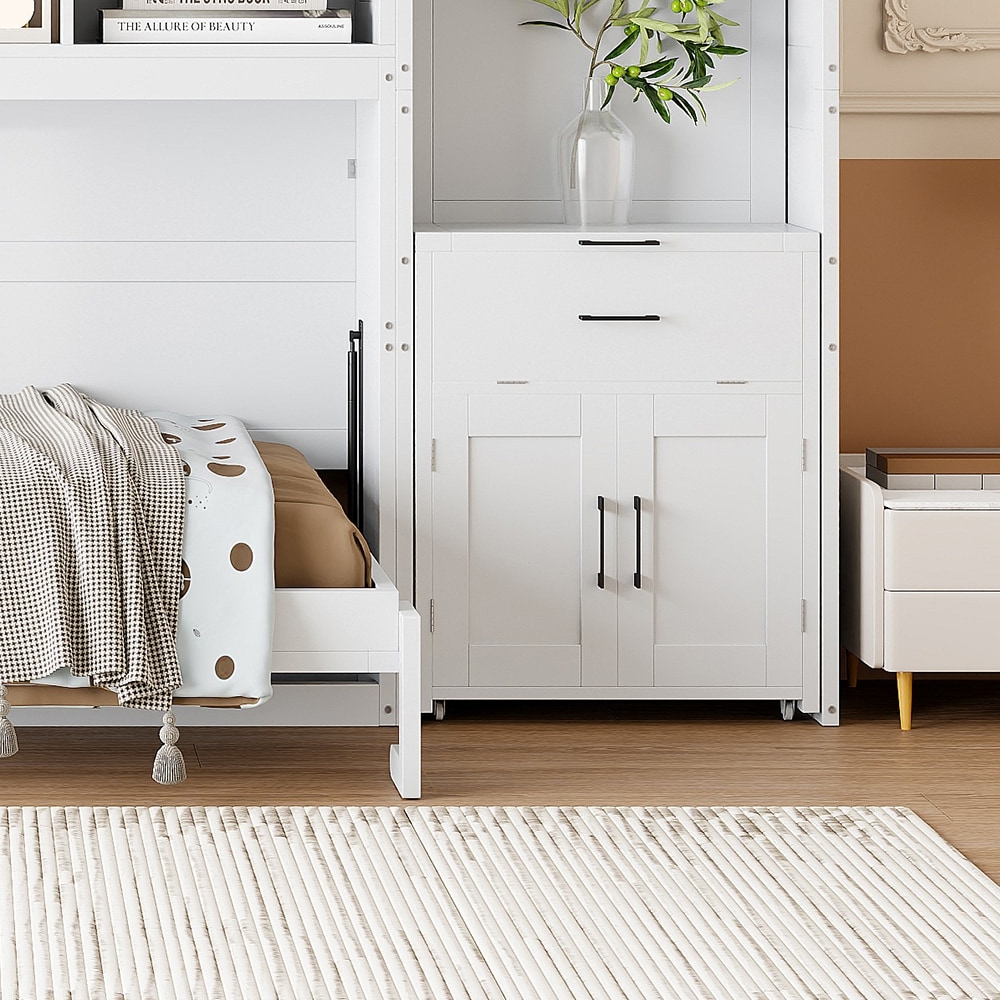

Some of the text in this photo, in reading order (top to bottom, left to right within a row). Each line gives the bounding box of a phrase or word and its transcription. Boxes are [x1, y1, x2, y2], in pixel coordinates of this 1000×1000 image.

[117, 22, 255, 31] THE ALLURE OF BEAUTY
